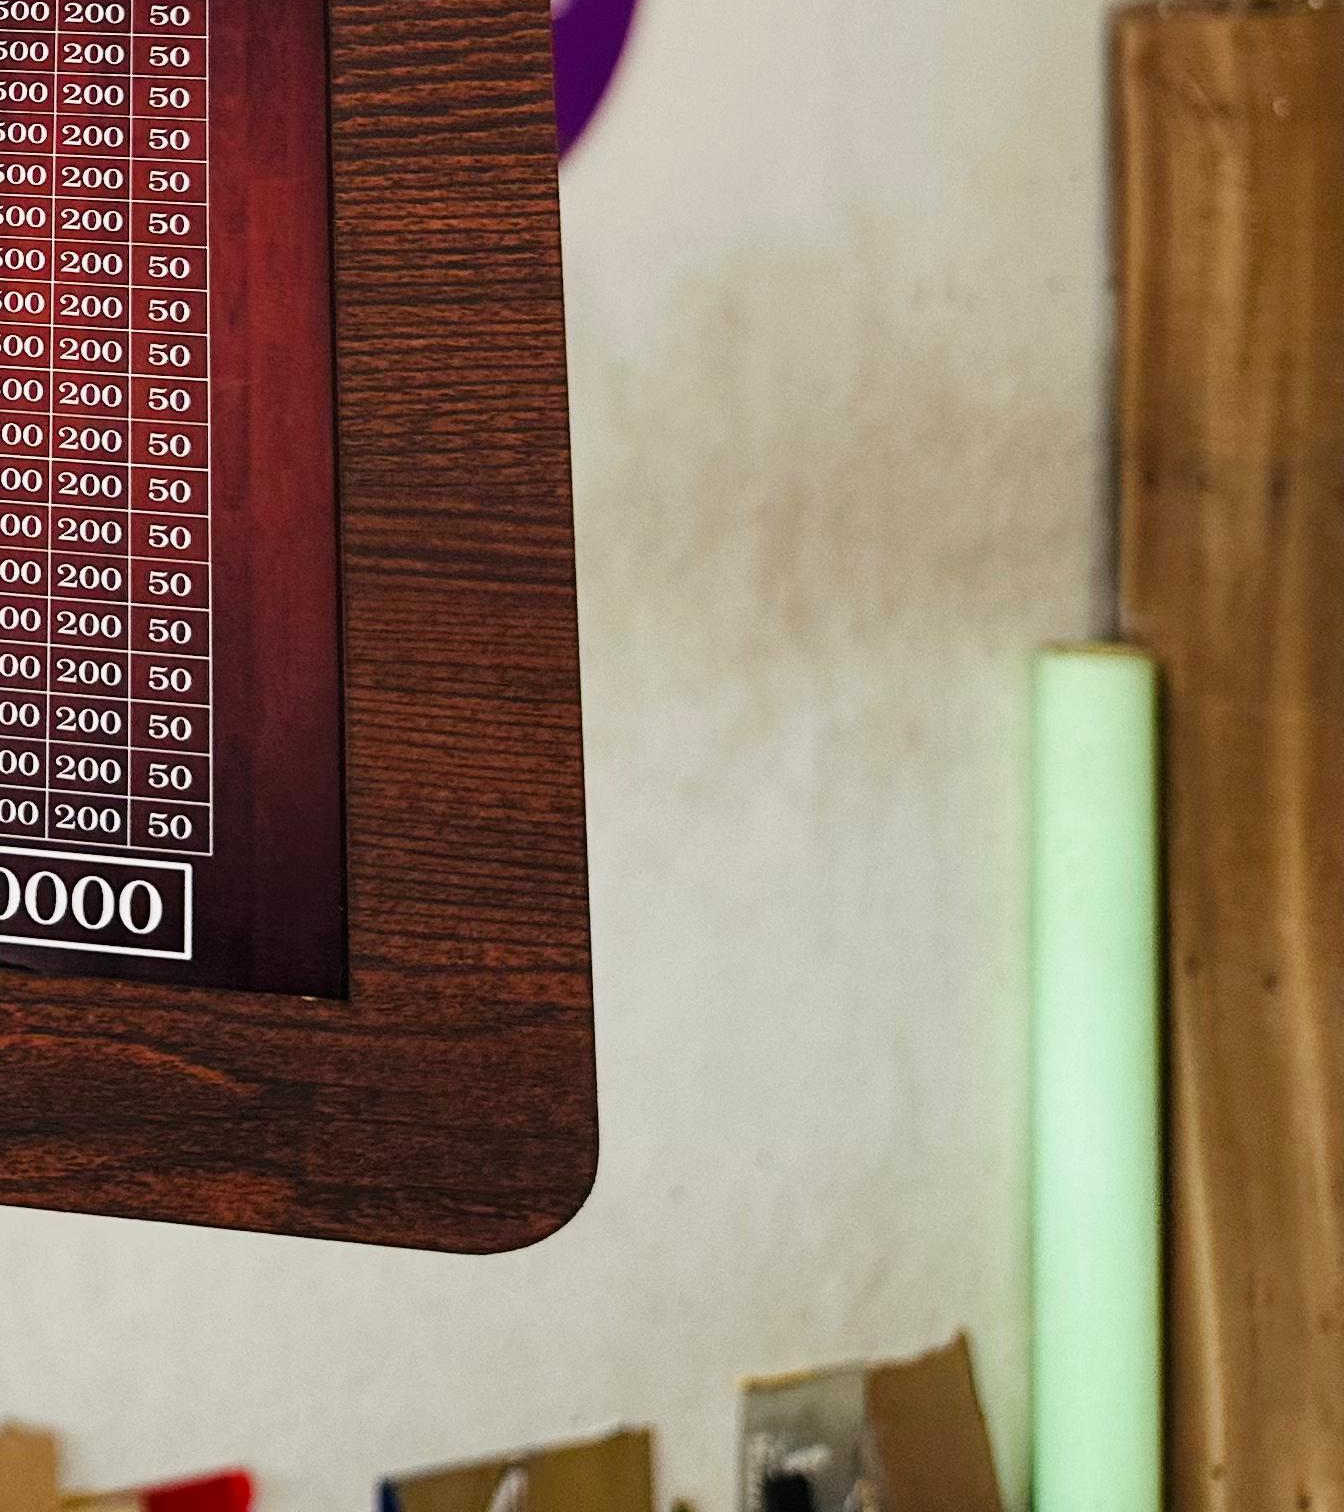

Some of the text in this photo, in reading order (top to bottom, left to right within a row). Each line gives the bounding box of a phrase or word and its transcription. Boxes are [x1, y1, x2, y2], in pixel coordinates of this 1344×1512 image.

[61, 124, 124, 148] 200
[148, 128, 191, 151] 50
[59, 294, 123, 319] 200
[148, 299, 191, 323] 50
[57, 471, 123, 498] 200
[148, 478, 192, 504] 50
[56, 658, 122, 686] 200
[148, 666, 192, 693] 50
[54, 803, 121, 833] 200
[147, 812, 193, 840] 50
